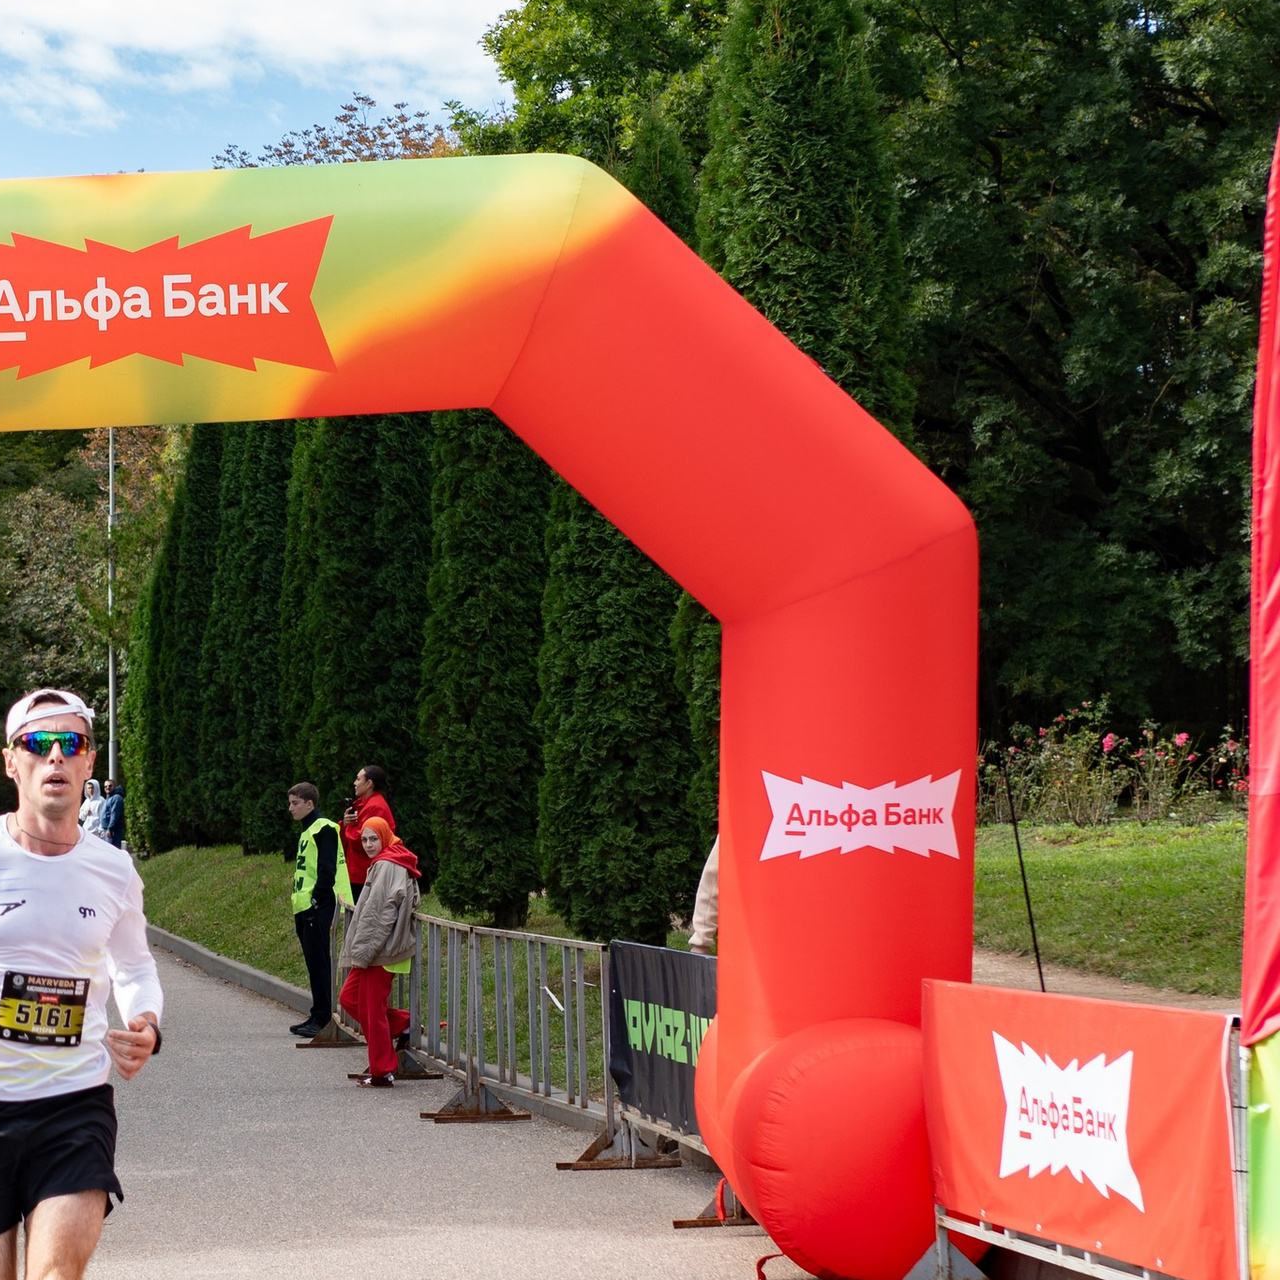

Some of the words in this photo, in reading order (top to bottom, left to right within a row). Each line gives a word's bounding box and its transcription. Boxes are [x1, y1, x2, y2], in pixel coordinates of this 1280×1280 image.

[163, 274, 290, 318] Банк
[786, 803, 877, 833] Альфа
[884, 803, 944, 825] Банк
[27, 977, 74, 988] MAYRVEDA
[15, 1004, 72, 1028] 5161
[1019, 1086, 1069, 1140] Альфа
[1072, 1097, 1117, 1142] Банк
